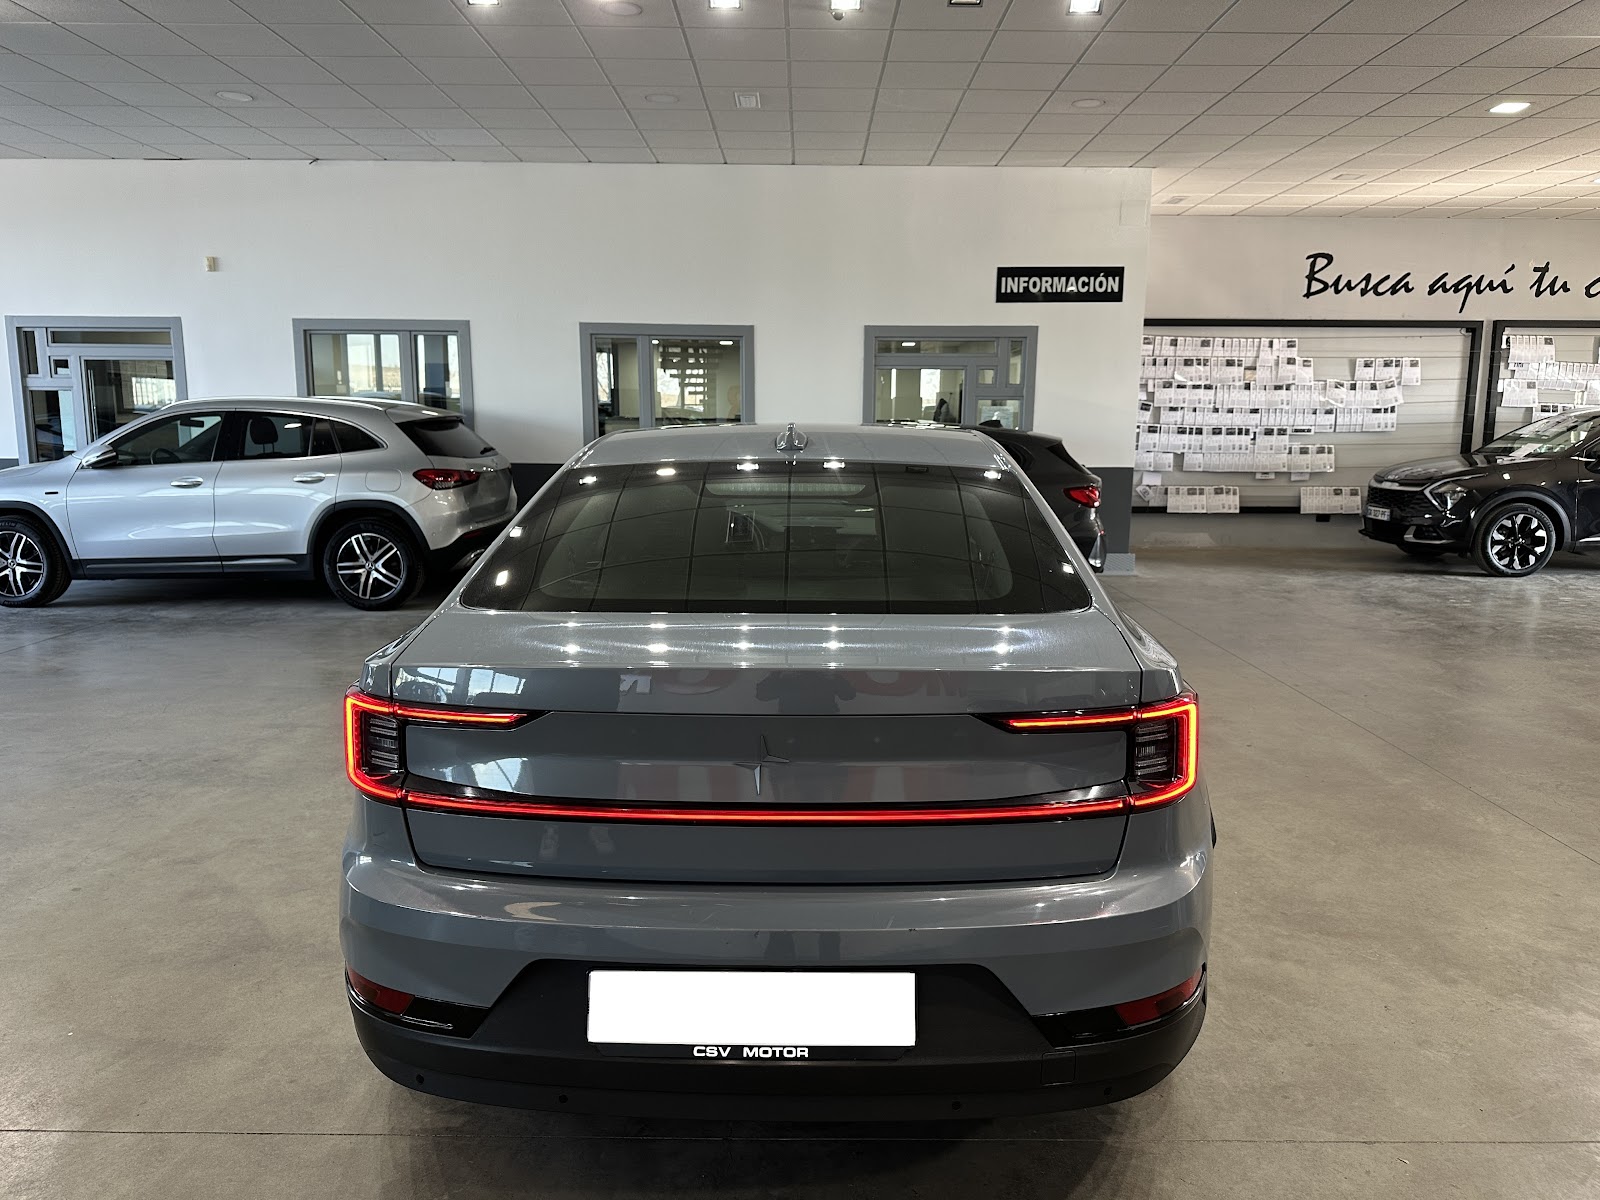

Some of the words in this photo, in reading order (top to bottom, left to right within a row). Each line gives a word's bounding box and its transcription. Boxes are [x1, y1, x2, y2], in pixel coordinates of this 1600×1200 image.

[1000, 272, 1120, 293] INFORMACIÓN
[1303, 252, 1414, 299] Busca
[1427, 263, 1515, 313] aquí
[1530, 261, 1571, 298] tu
[693, 1046, 731, 1058] CSV
[743, 1046, 809, 1058] MOTOR
